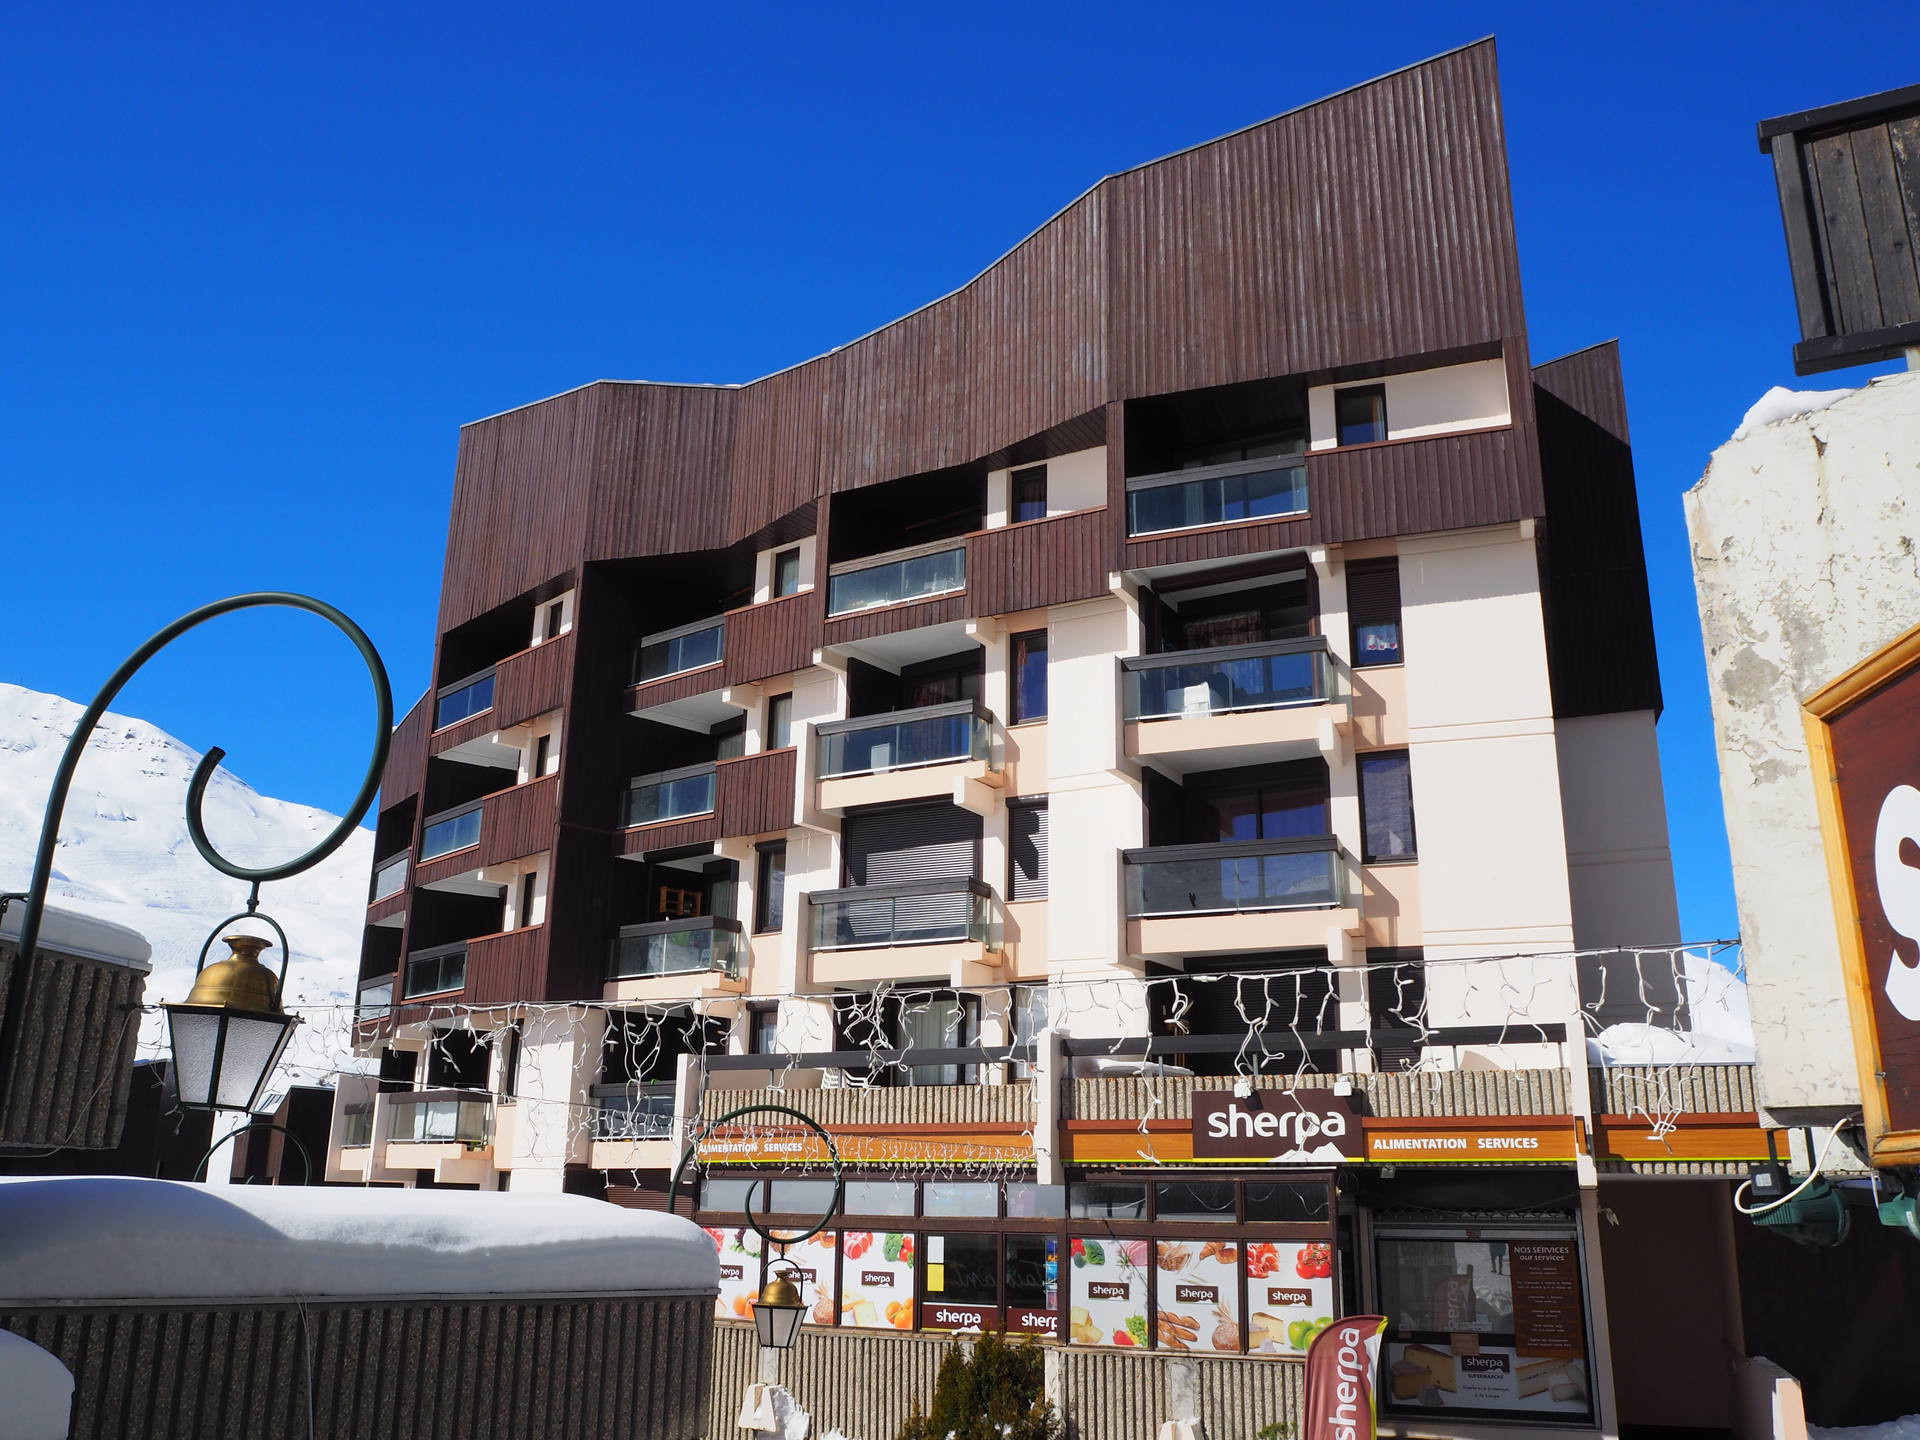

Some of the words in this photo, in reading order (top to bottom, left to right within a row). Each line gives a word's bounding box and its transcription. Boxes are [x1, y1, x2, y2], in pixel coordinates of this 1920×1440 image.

[1207, 1104, 1346, 1144] sherpa
[763, 1142, 803, 1152] SERVICES
[1373, 1138, 1467, 1150] ALIMENTATION
[1477, 1137, 1539, 1149] SERVICES
[1513, 1246, 1531, 1254] NOS
[1532, 1246, 1569, 1254] SERVICES
[720, 1267, 740, 1277] herpa
[864, 1273, 891, 1284] sherpa
[1092, 1283, 1125, 1298] sherpa
[1180, 1287, 1214, 1301] sherpa
[1271, 1290, 1307, 1304] sherpa
[936, 1308, 982, 1326] sherpa
[1021, 1312, 1058, 1330] sherp
[1466, 1356, 1504, 1369] sherpa
